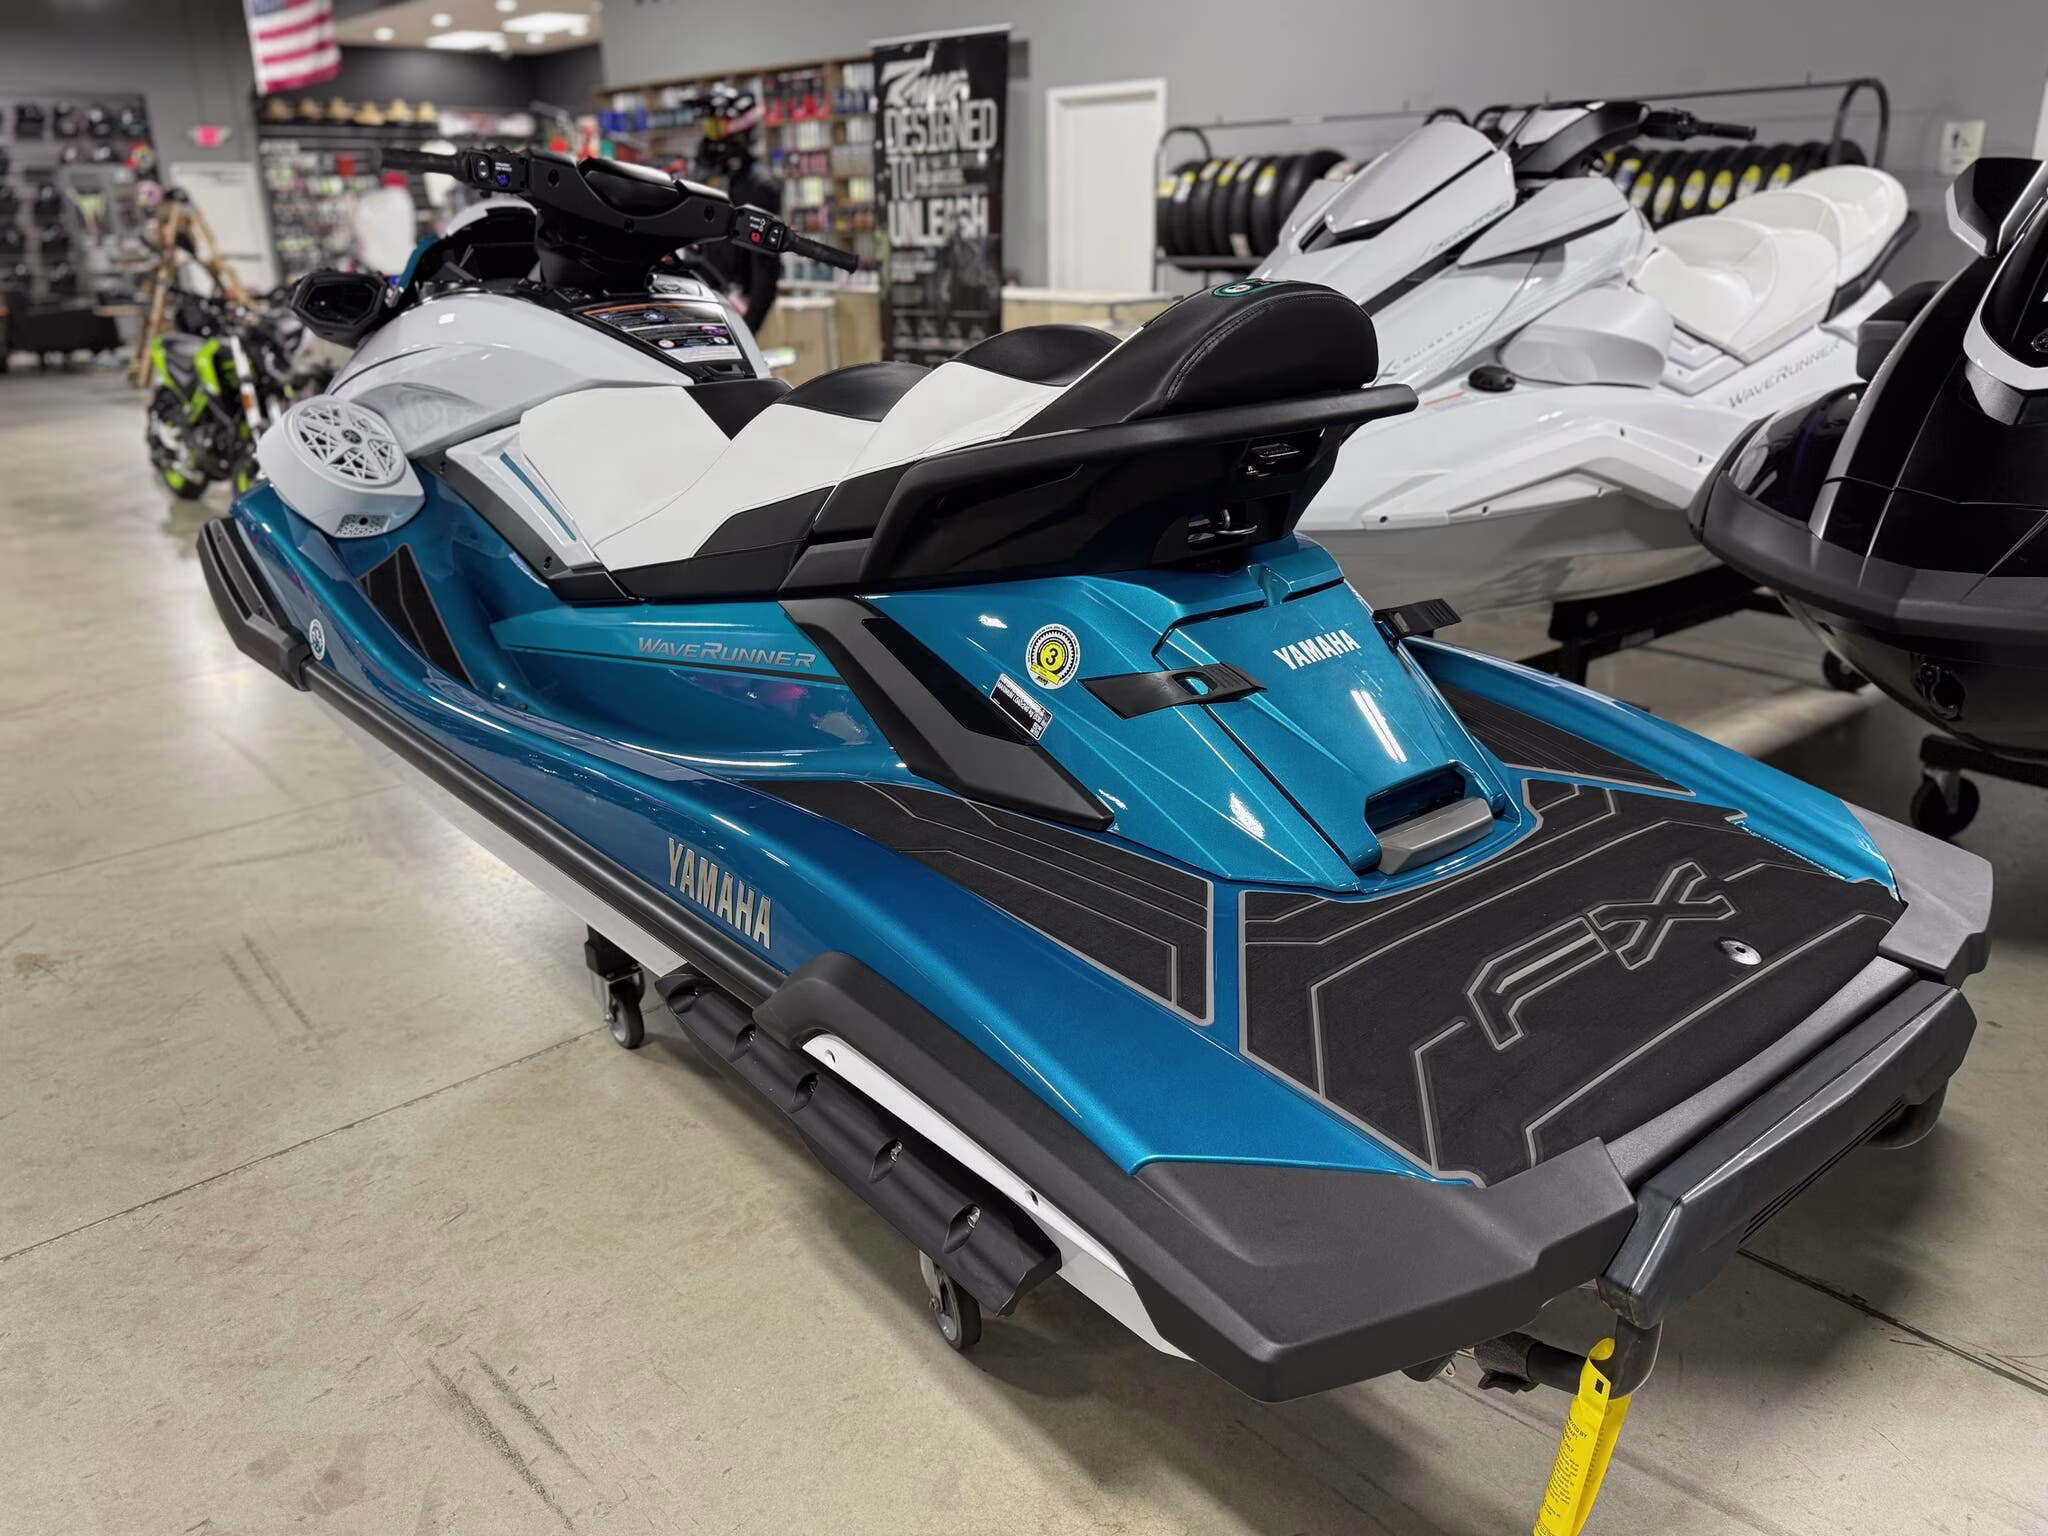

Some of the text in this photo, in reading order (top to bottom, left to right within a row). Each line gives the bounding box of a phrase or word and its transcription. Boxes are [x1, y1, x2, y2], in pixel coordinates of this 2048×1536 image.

[883, 98, 998, 156] DESIGNED
[888, 193, 989, 247] UNLEASH
[638, 636, 817, 668] WAVERUNNER
[1045, 647, 1059, 666] 3
[1271, 628, 1362, 671] YAMAHA
[668, 836, 771, 950] YAMAHA
[1465, 860, 1737, 1052] FX
